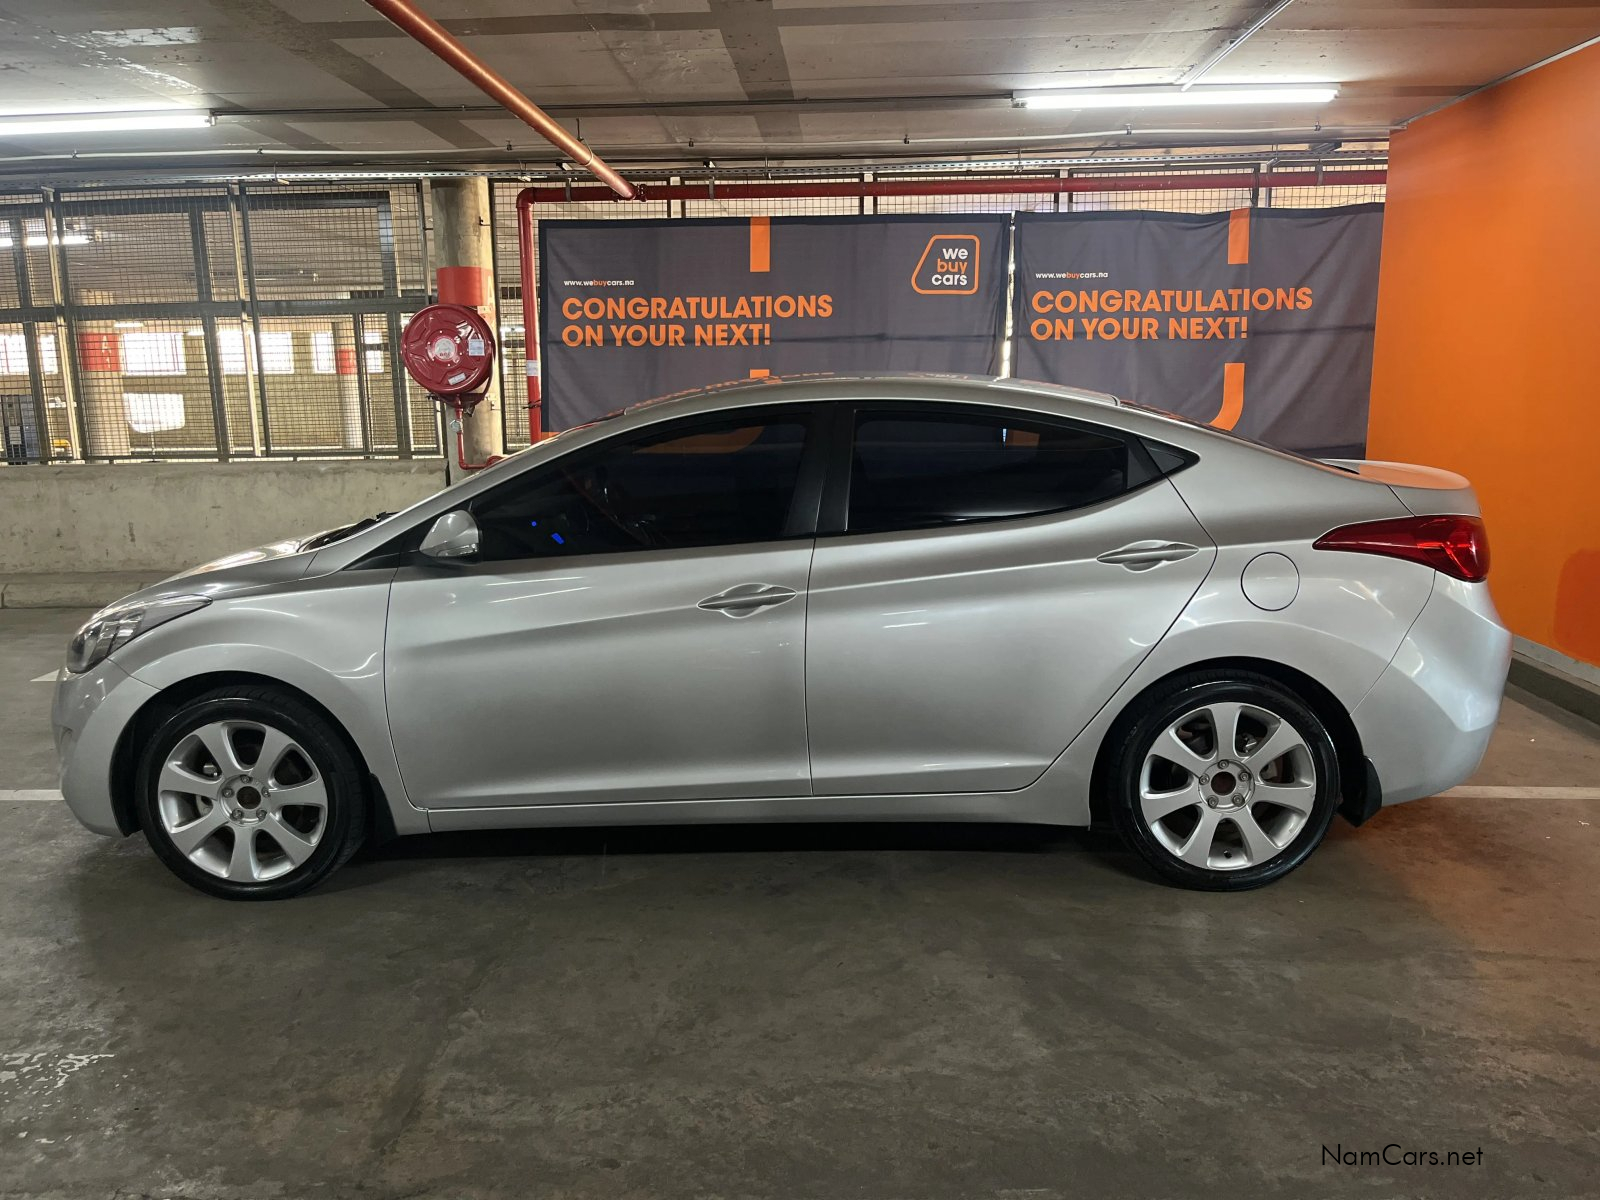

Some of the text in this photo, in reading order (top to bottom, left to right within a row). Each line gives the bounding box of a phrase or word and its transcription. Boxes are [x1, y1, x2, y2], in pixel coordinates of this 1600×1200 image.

[942, 248, 968, 260] we
[937, 258, 968, 274] buy
[563, 279, 635, 287] www.webuycars.na
[931, 274, 968, 286] cars
[1035, 271, 1109, 280] www.webuycars.na
[561, 295, 833, 320] CONGRATULATIONS
[1031, 287, 1313, 313] CONGRATULATIONS
[561, 323, 771, 348] ON YOUR NEXT!
[1030, 316, 1249, 341] ON YOUR NEXT!
